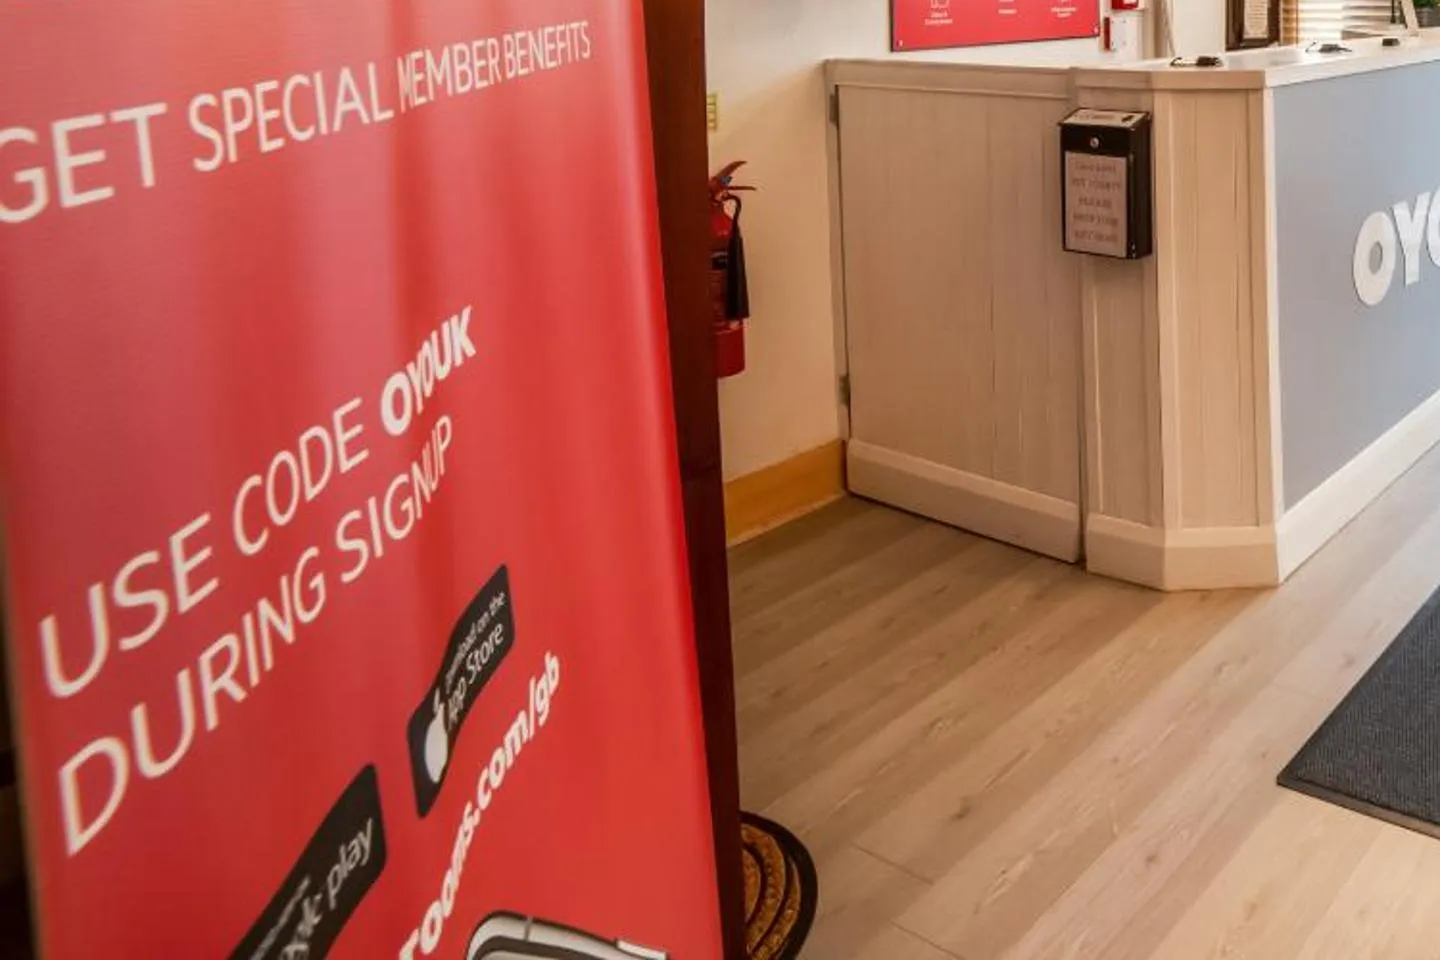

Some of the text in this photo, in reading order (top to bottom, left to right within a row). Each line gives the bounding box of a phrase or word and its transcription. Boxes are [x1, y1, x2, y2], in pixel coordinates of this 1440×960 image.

[0, 20, 592, 223] GET SPECIAL MEMBER BENEFITS
[39, 305, 477, 700] USE CODE OYOUK
[57, 415, 453, 858] DURING SIGNUP
[465, 622, 505, 685] Store
[326, 816, 373, 911] play
